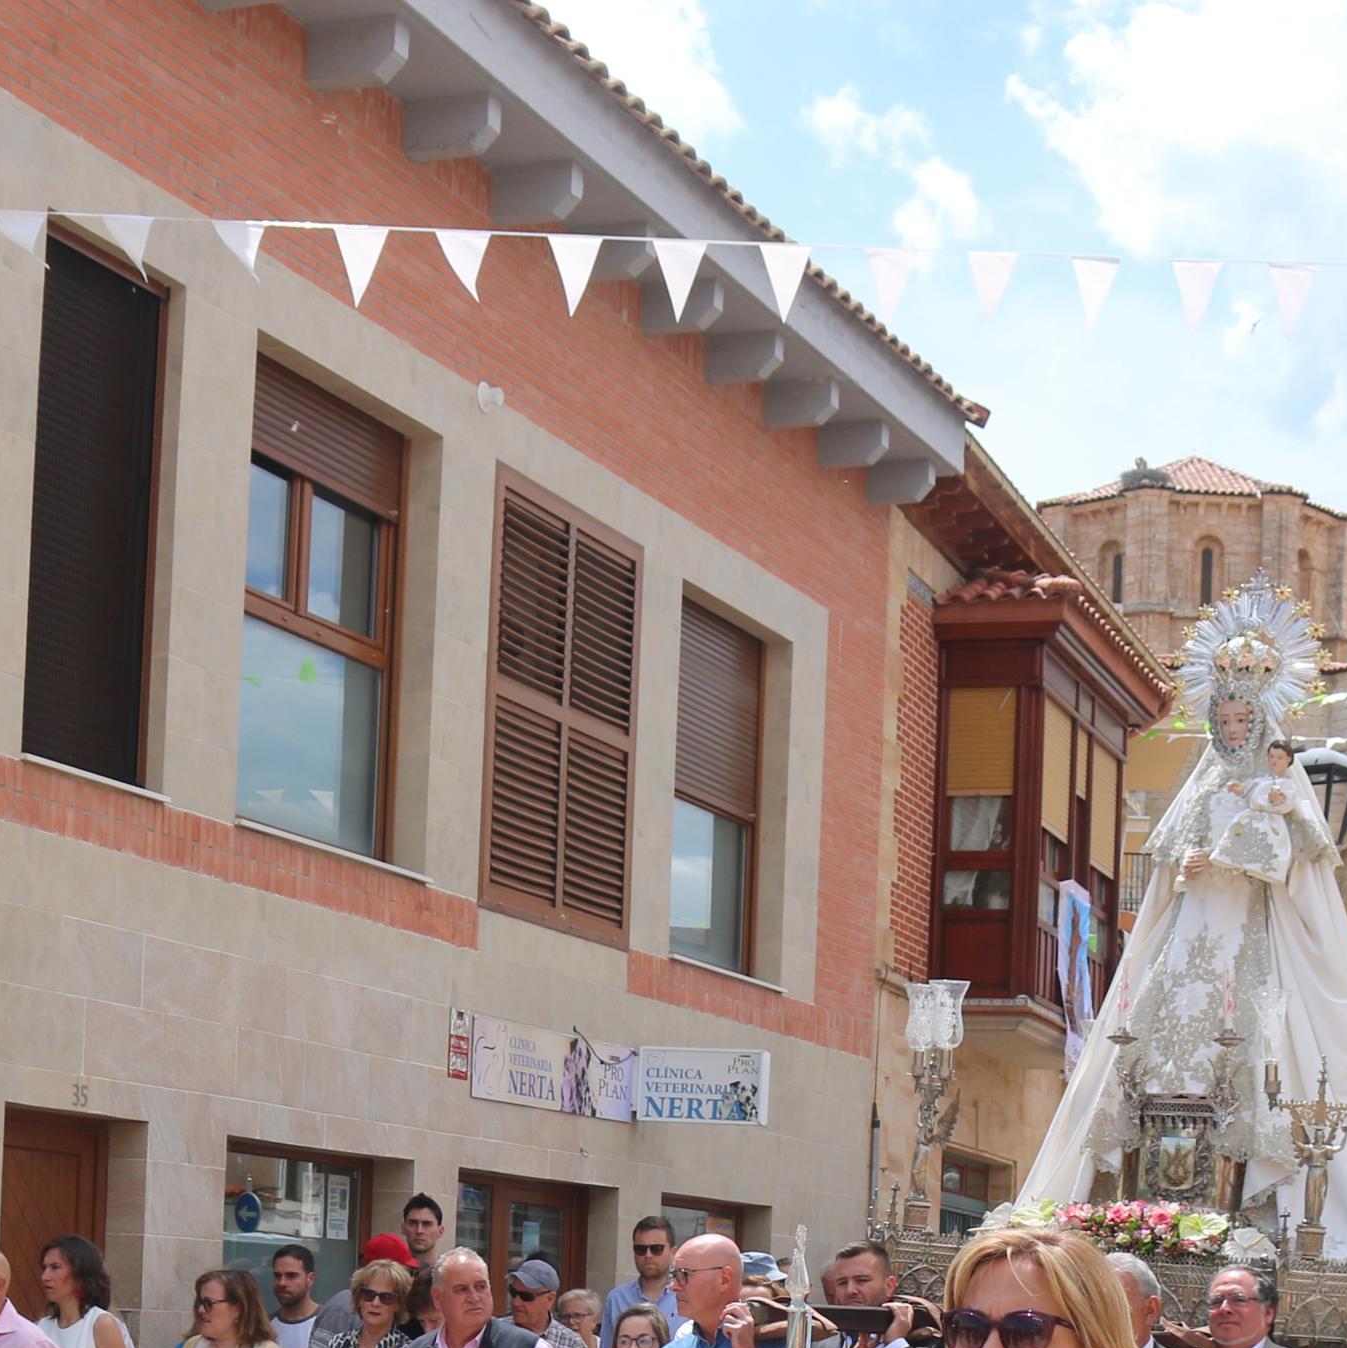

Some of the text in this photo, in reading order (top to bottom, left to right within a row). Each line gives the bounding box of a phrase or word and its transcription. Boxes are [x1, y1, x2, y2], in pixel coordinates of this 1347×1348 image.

[508, 1052, 552, 1073] VETERINARIA
[603, 1063, 625, 1082] PRO
[646, 1064, 703, 1080] CLÍNICA
[727, 1065, 759, 1075] PLAN
[732, 1057, 756, 1067] PRO
[508, 1069, 556, 1101] NERTA
[598, 1078, 628, 1100] PLAN
[72, 1084, 89, 1108] 35
[643, 1096, 746, 1121] NERTA
